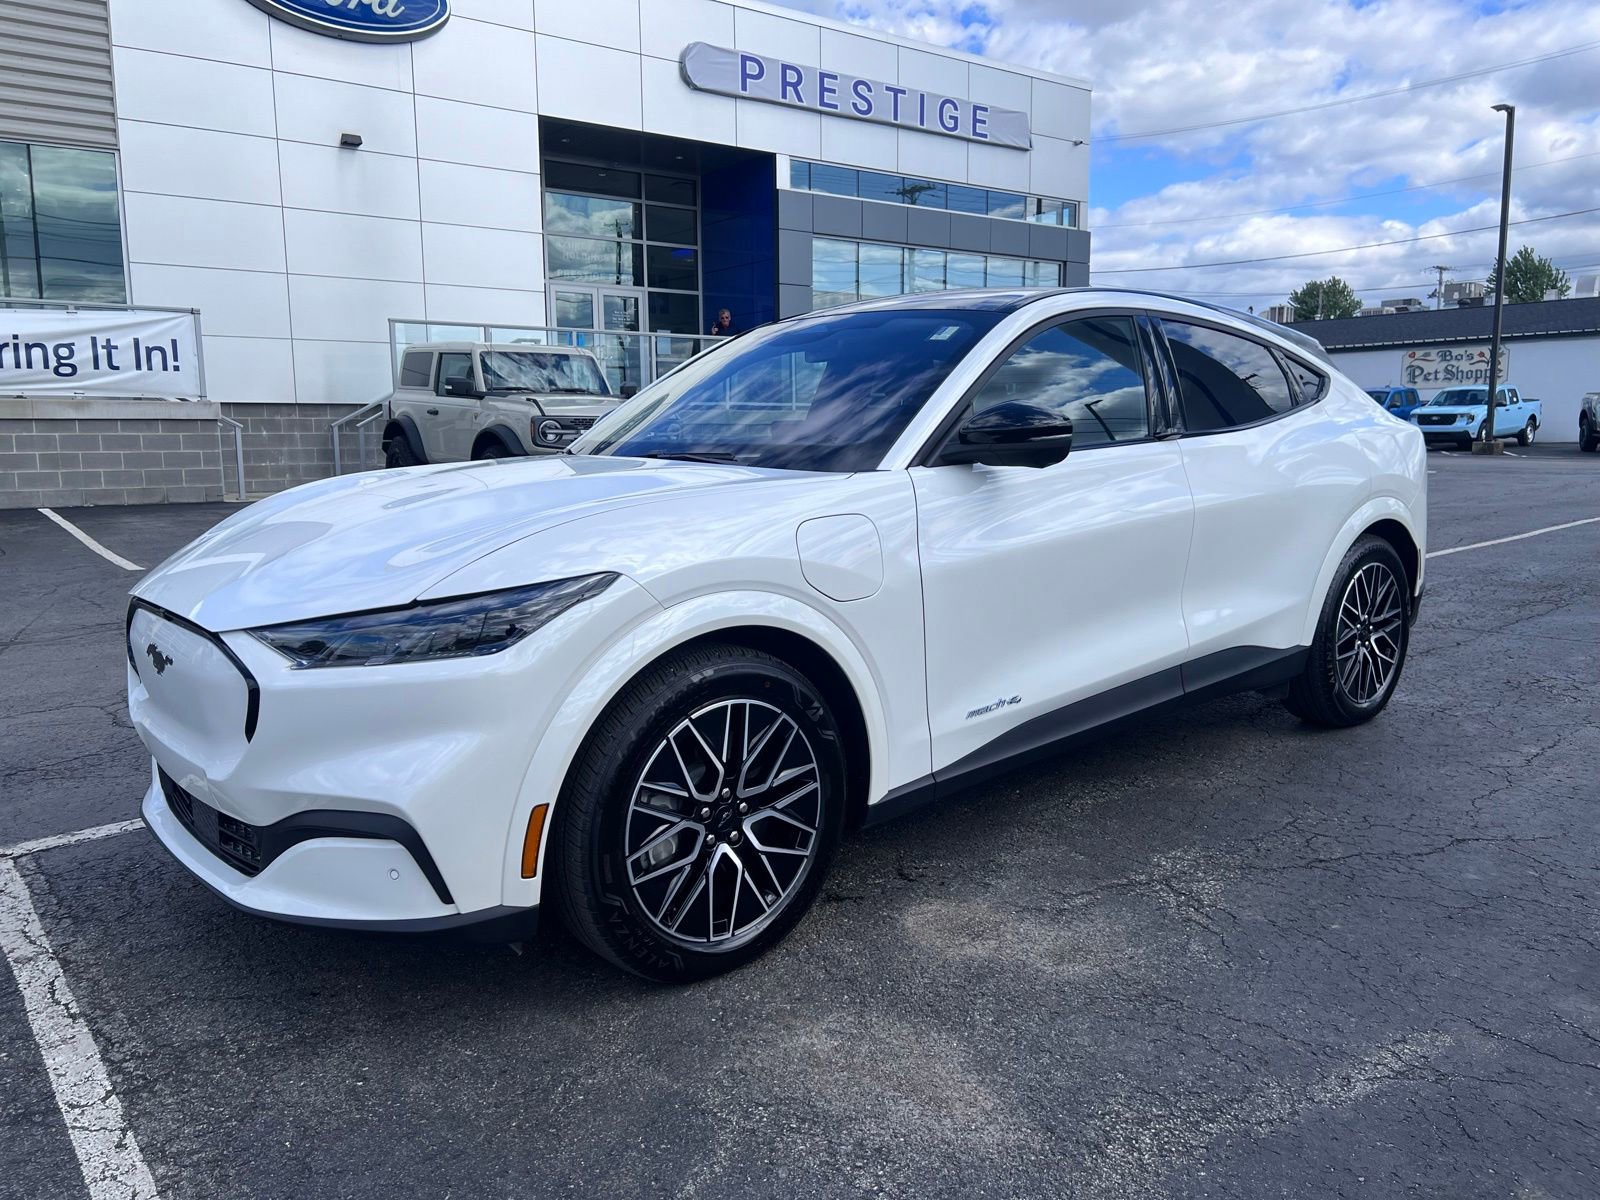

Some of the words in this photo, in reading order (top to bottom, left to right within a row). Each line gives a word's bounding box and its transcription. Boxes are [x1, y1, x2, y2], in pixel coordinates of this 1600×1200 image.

[739, 53, 990, 140] PRESTIGE
[90, 336, 120, 371] It
[133, 337, 181, 372] In!
[1436, 349, 1474, 362] Bo's
[1405, 364, 1441, 385] Pet
